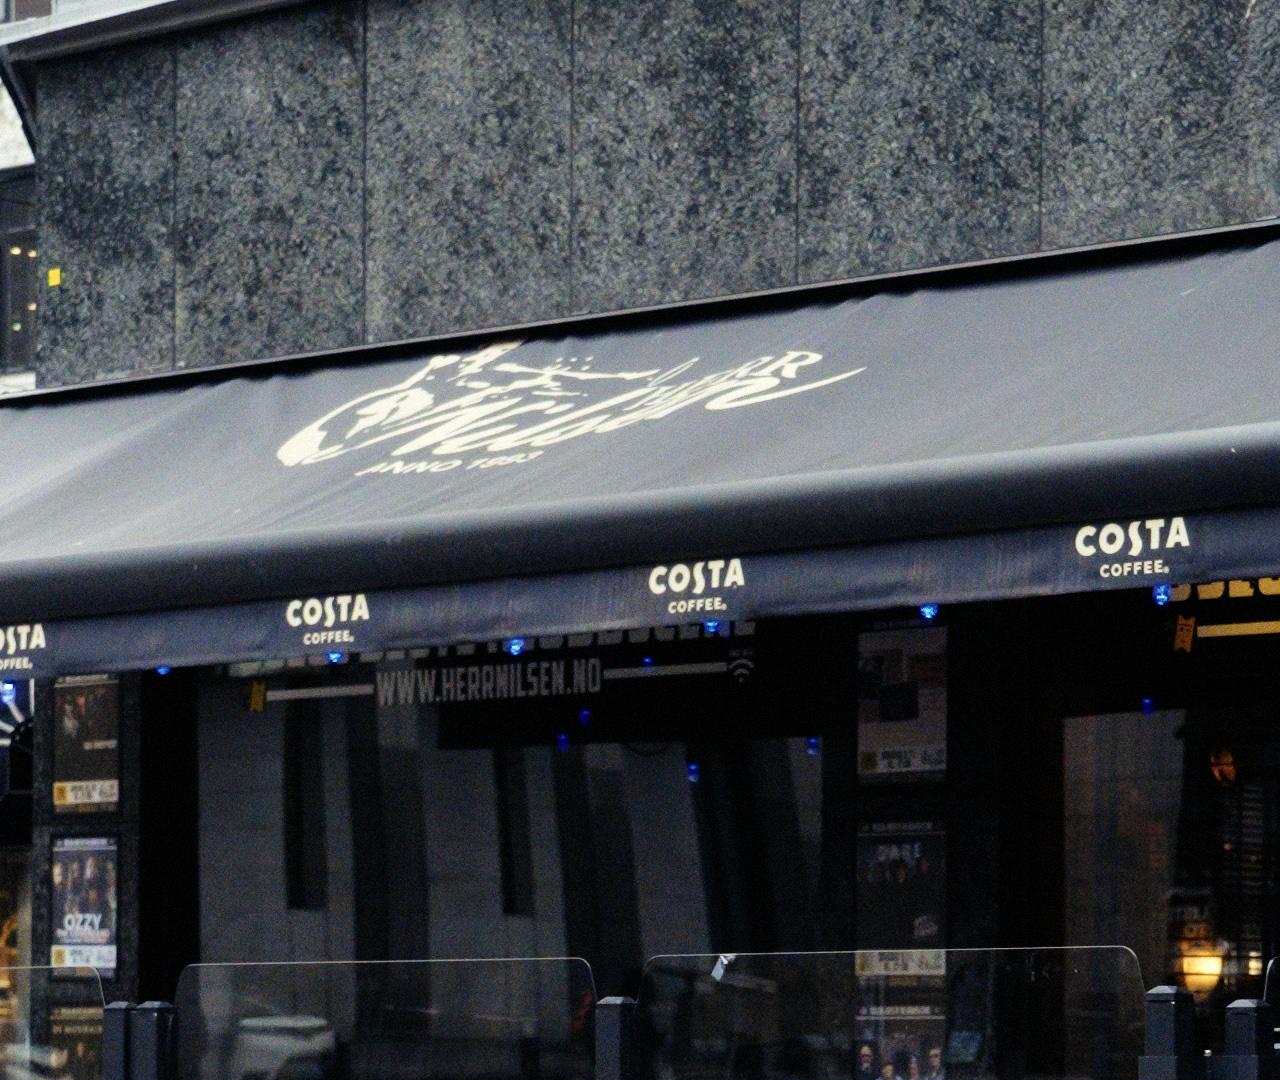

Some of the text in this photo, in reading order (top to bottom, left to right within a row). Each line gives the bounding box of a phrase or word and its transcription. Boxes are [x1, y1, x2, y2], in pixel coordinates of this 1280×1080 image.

[1075, 518, 1191, 557] COSTA
[649, 559, 745, 595] COSTA
[286, 595, 370, 628] COSTA
[377, 658, 601, 707] WWW.HERRNILSEN.NO
